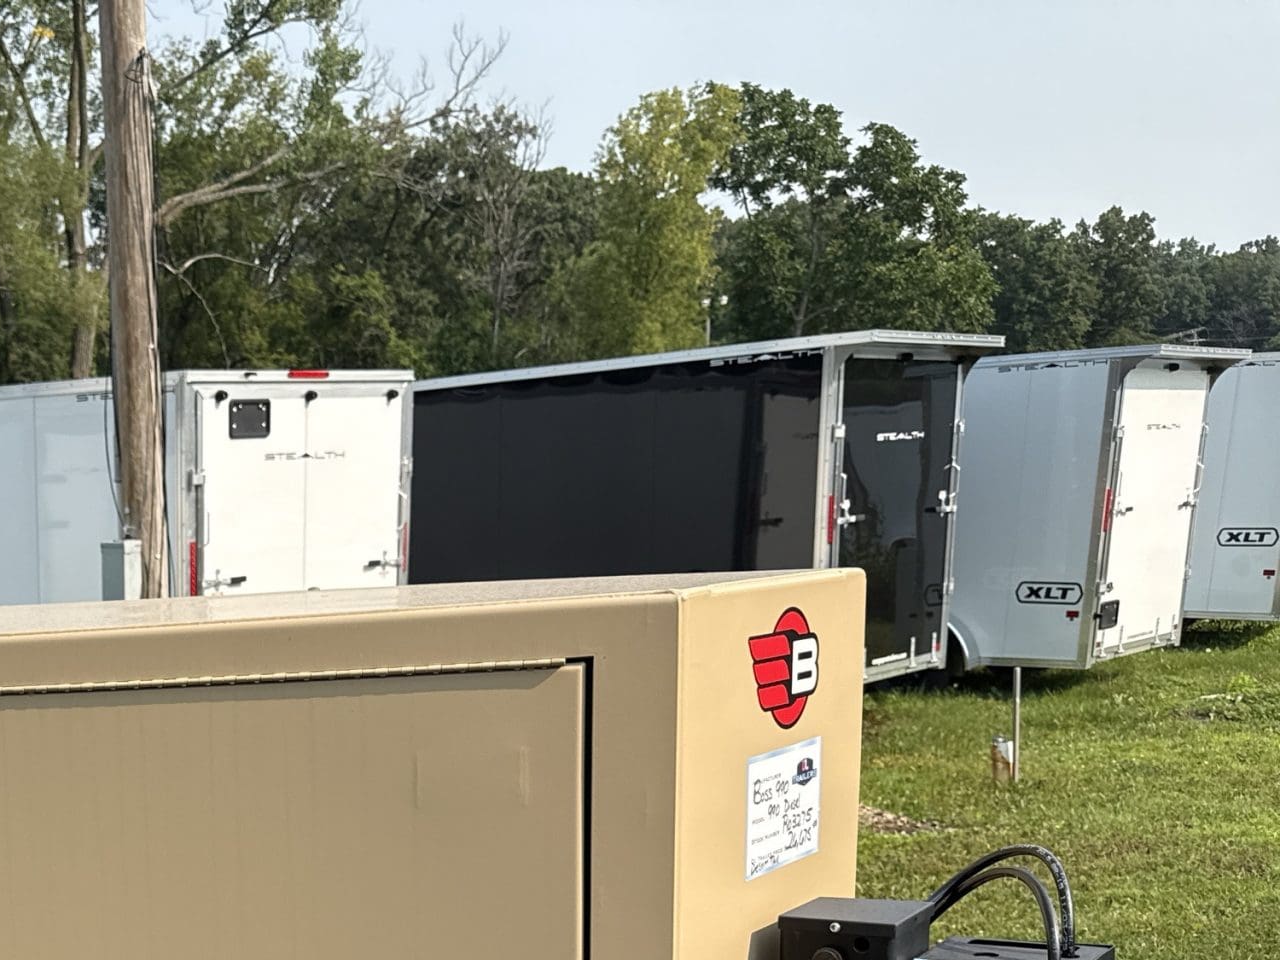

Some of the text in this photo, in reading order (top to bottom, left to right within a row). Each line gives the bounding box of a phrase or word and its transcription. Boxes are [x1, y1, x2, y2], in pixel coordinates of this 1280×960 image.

[876, 431, 925, 441] STEALTH
[264, 451, 346, 461] STEALTH
[1224, 531, 1272, 543] XLT
[1024, 586, 1075, 600] XLT
[791, 637, 818, 695] B
